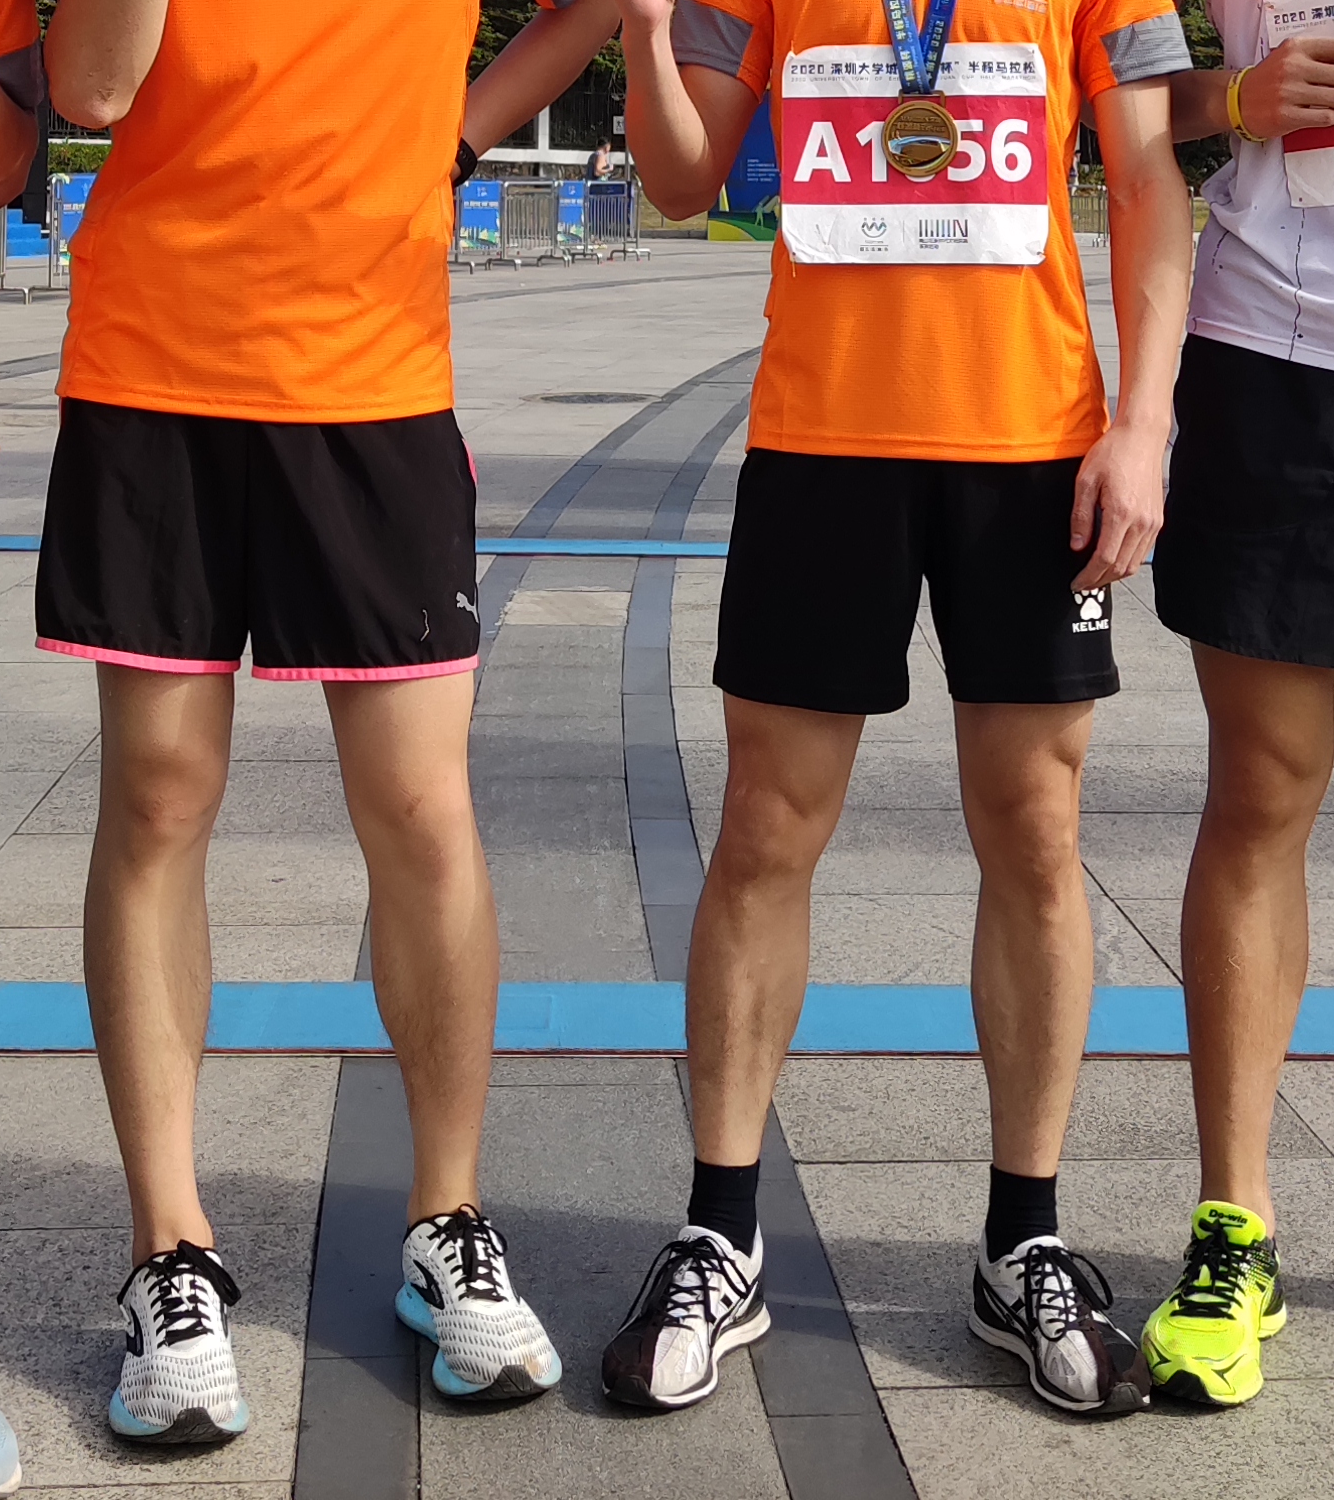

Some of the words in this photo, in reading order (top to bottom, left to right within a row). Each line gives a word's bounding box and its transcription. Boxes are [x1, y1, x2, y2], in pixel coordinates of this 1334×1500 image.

[1273, 12, 1306, 25] 2020
[790, 63, 825, 76] 2020
[968, 60, 1036, 75] 半程马拉松
[793, 119, 1033, 183] A156
